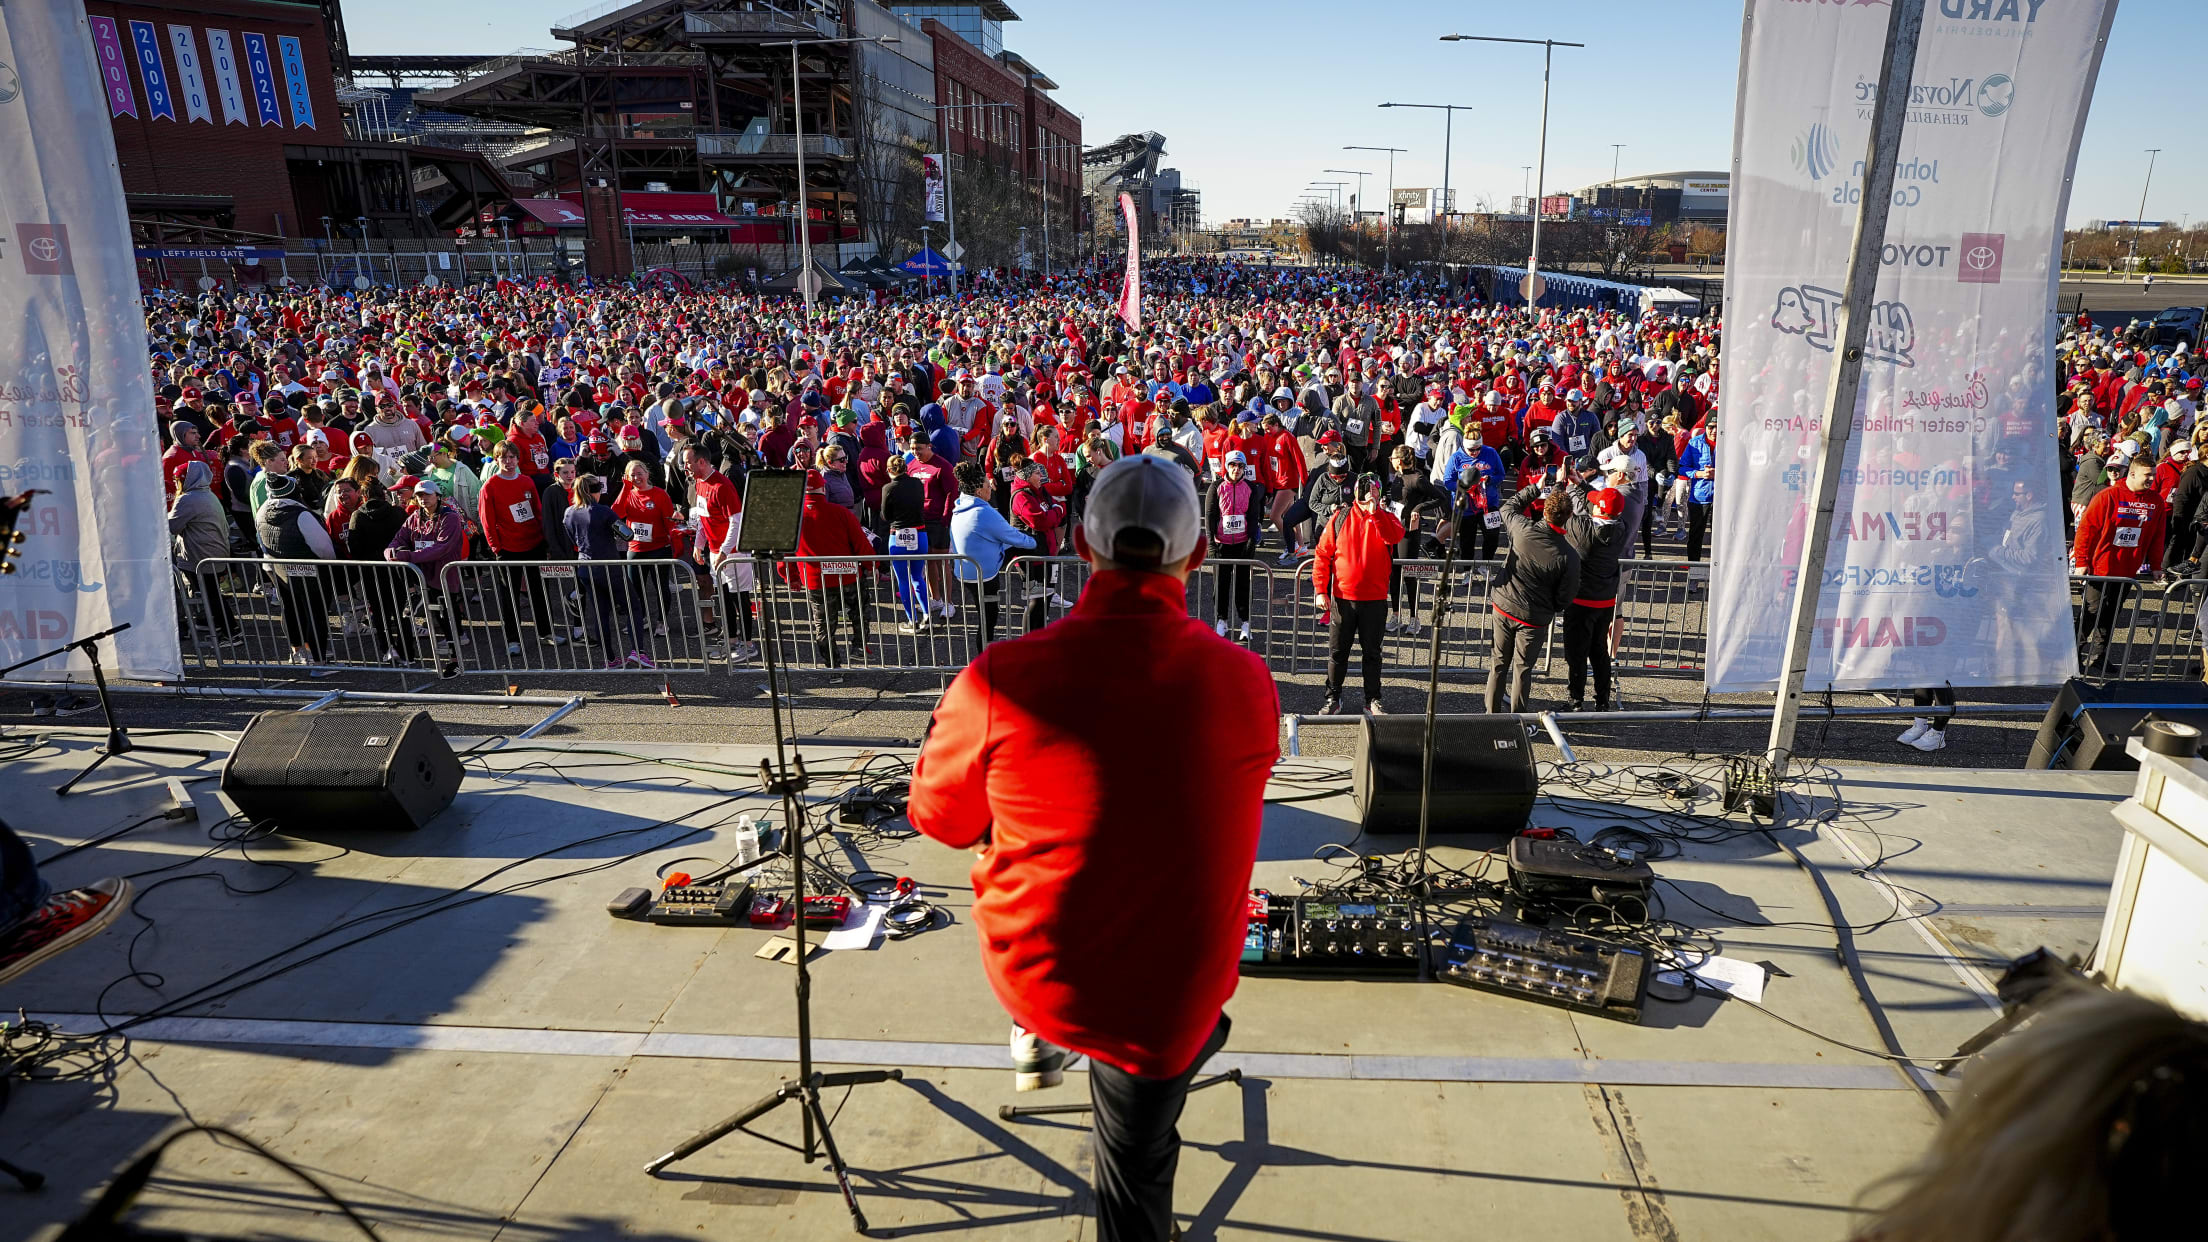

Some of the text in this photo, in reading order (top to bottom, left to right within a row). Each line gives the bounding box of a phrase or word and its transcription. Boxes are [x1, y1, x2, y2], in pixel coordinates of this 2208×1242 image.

[100, 23, 126, 103] 2008
[139, 28, 163, 105] 2009
[177, 32, 201, 108] 2010
[215, 36, 236, 111] 2011
[251, 39, 273, 113] 2022
[286, 42, 306, 115] 2023
[2117, 507, 2148, 515] SERIES
[2119, 533, 2137, 541] 4818
